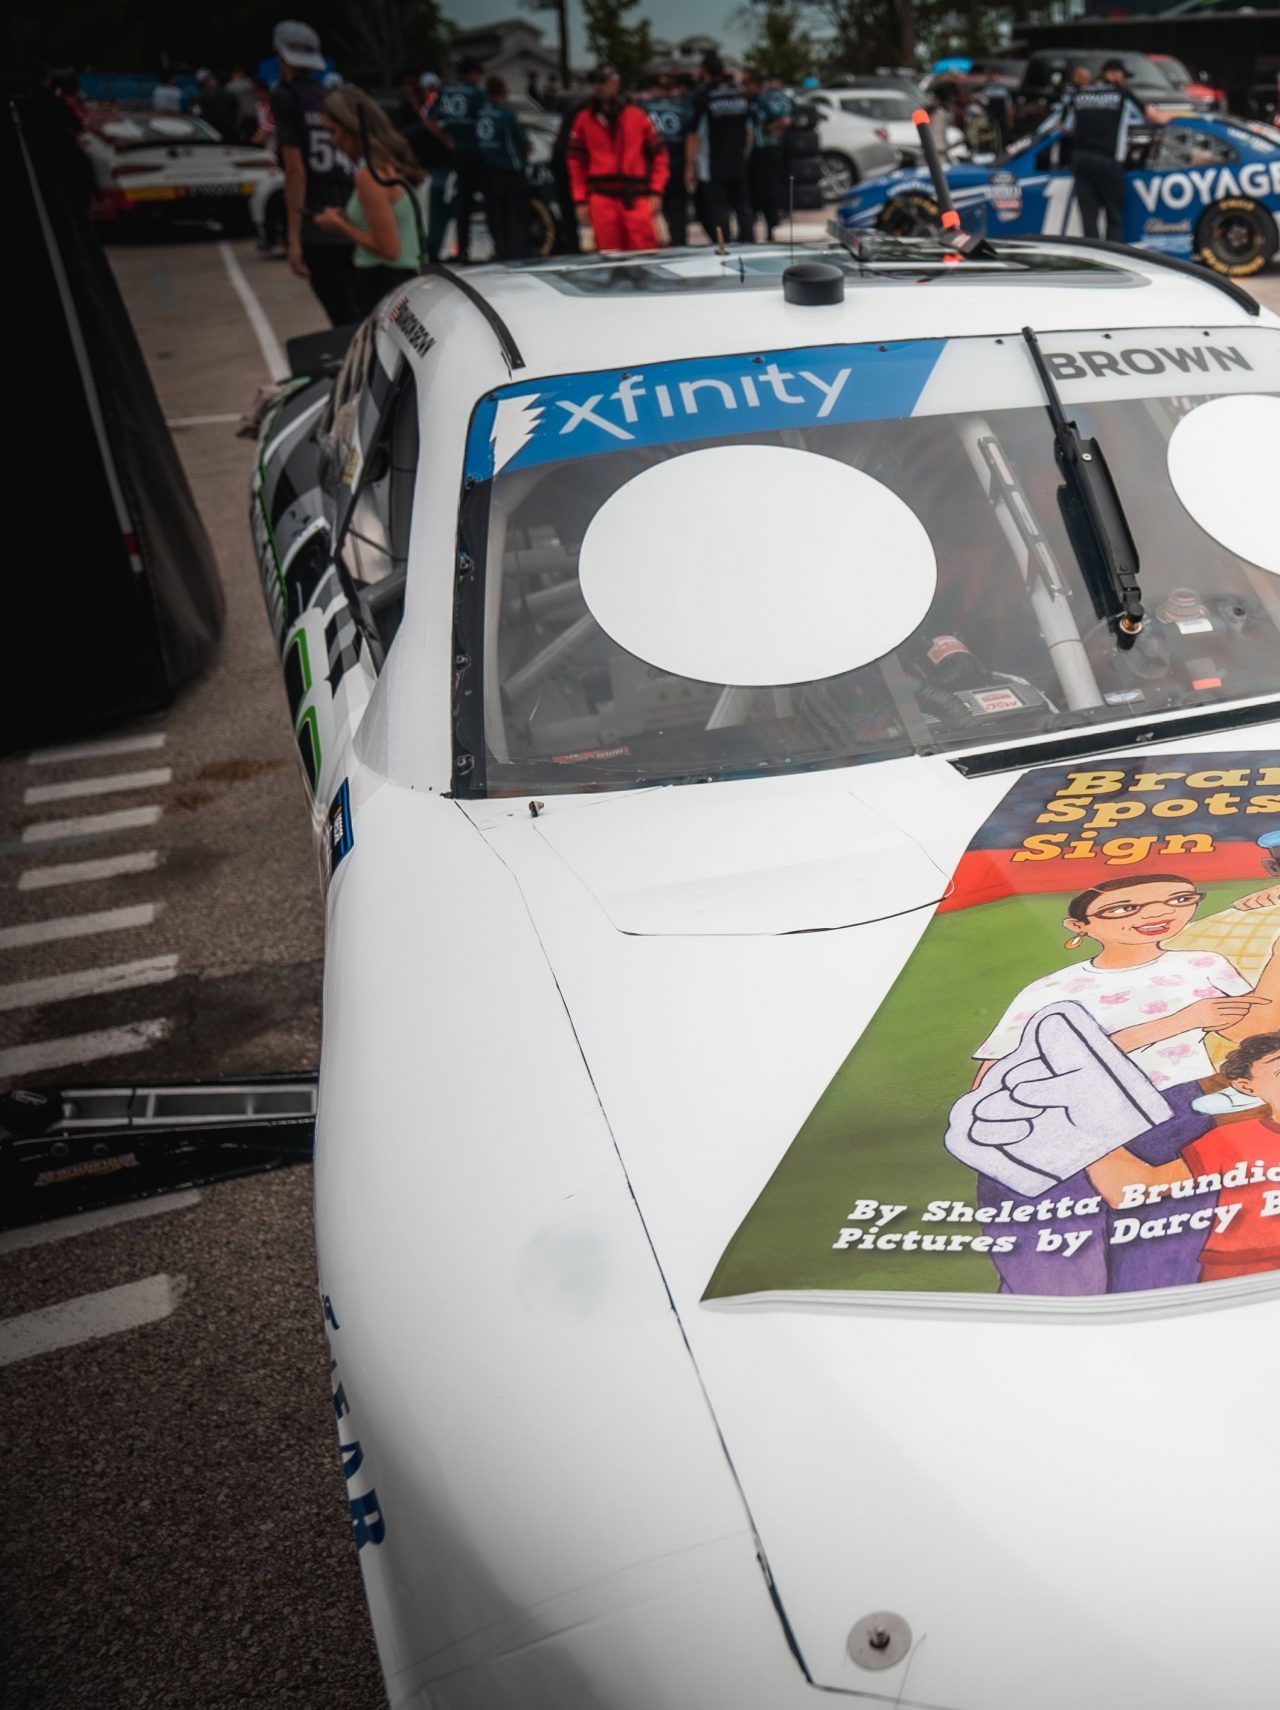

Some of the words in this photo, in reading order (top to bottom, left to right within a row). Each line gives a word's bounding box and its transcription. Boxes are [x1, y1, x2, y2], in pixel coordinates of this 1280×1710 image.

[1046, 346, 1253, 381] BROWN
[557, 366, 852, 440] xfinity
[1011, 829, 1216, 866] Sign
[832, 1228, 1017, 1253] Pictures
[1035, 1228, 1093, 1257] by
[1110, 1202, 1243, 1245] Darcy
[847, 1199, 907, 1227] By
[920, 1195, 1103, 1224] Sheletta
